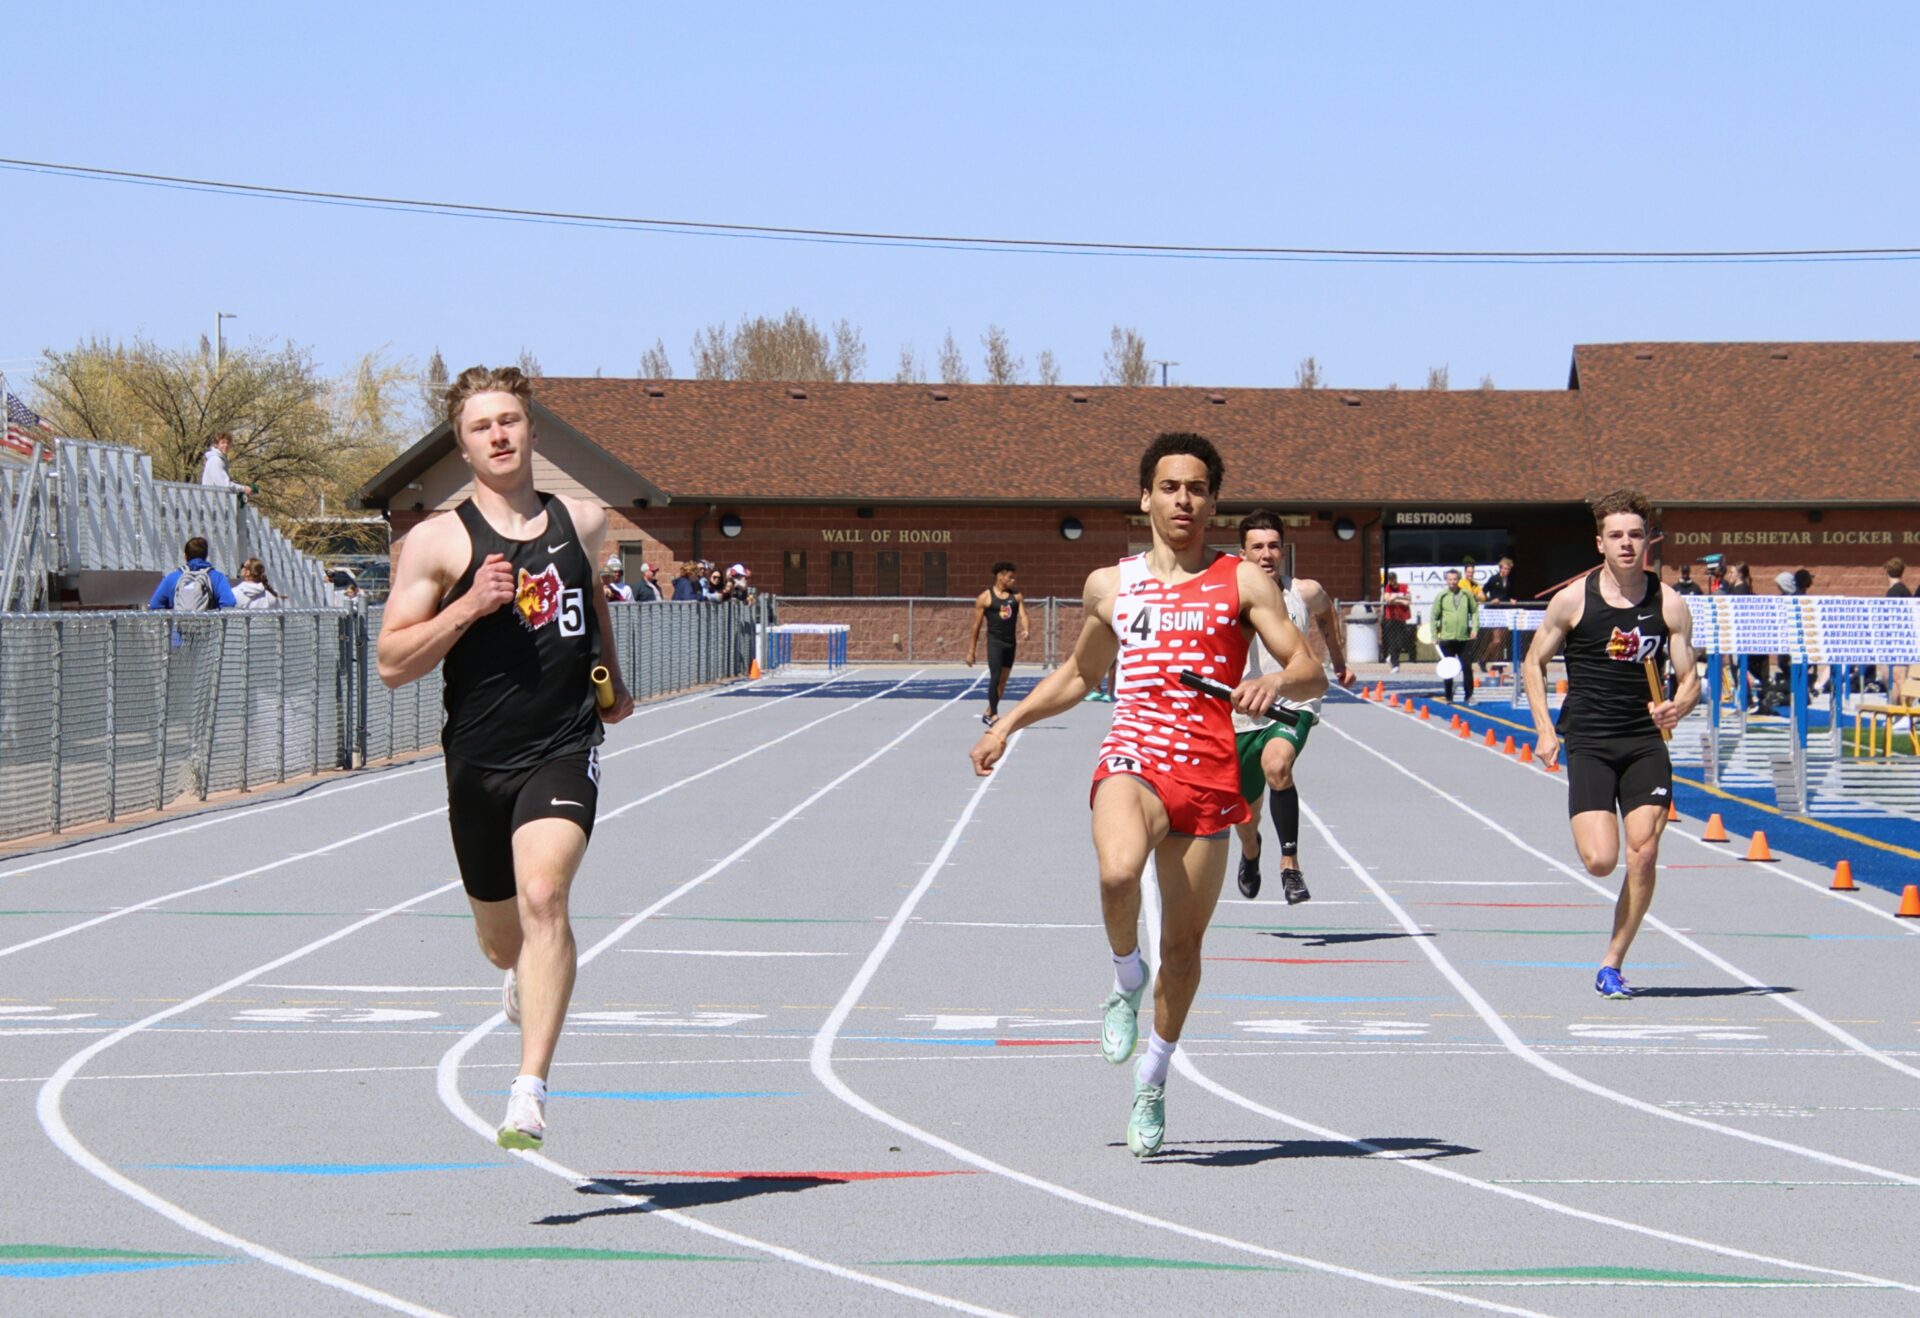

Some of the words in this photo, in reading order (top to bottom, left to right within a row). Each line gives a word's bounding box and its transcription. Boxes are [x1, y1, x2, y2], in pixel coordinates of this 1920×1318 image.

[1396, 512, 1473, 525] RESTROOMS
[821, 529, 864, 543] WALL
[870, 529, 892, 543] OF
[899, 530, 952, 543] HONOR
[1674, 531, 1712, 545] DON
[1720, 531, 1813, 545] RESHETAR
[1822, 531, 1893, 544] LOCKER
[561, 591, 582, 632] 5
[1130, 605, 1153, 641] 4
[1157, 610, 1204, 631] SUM
[1641, 638, 1657, 660] 2
[1113, 756, 1135, 770] 4
